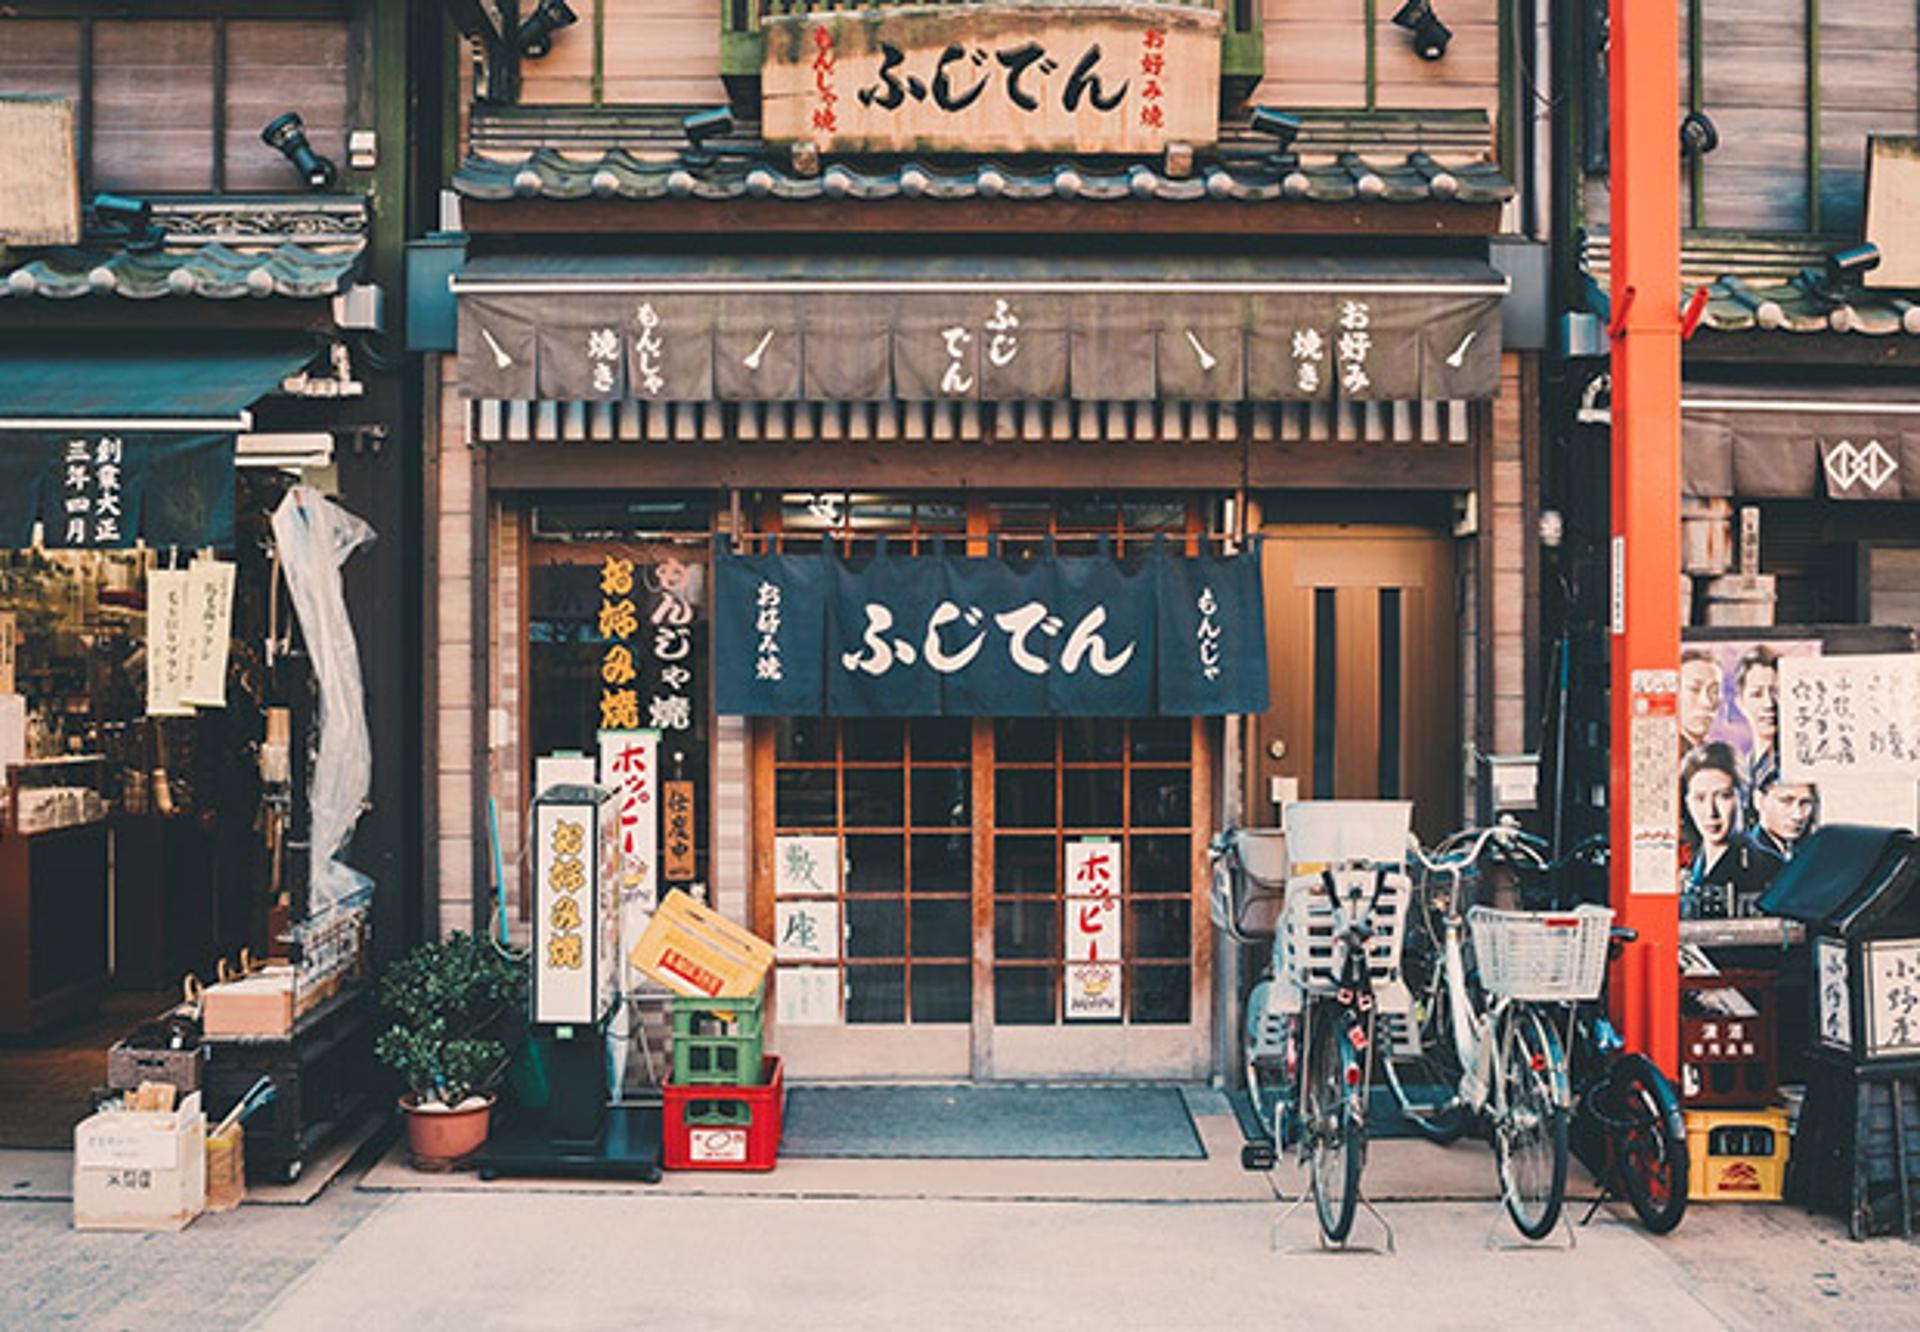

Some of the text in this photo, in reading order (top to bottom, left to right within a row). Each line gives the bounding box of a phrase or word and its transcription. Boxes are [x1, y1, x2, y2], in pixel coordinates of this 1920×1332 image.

[858, 42, 1130, 112] ふじでん
[1141, 26, 1168, 129] お好み焼
[587, 328, 619, 392] 焼き
[636, 301, 664, 395] もんじゃ
[940, 326, 973, 392] でん
[984, 298, 1019, 366] ふじ
[1292, 328, 1323, 392] 焼き
[1338, 300, 1372, 395] お好み
[65, 440, 91, 544] 三年四月
[95, 437, 122, 542] 創業大正
[598, 554, 639, 730] お好み焼
[648, 556, 693, 730] もんじゃ焼
[755, 581, 784, 681] お好み焼
[842, 601, 1137, 676] ふじでん
[1197, 586, 1222, 682] もんじゃ
[1076, 850, 1115, 963] ホッピー
